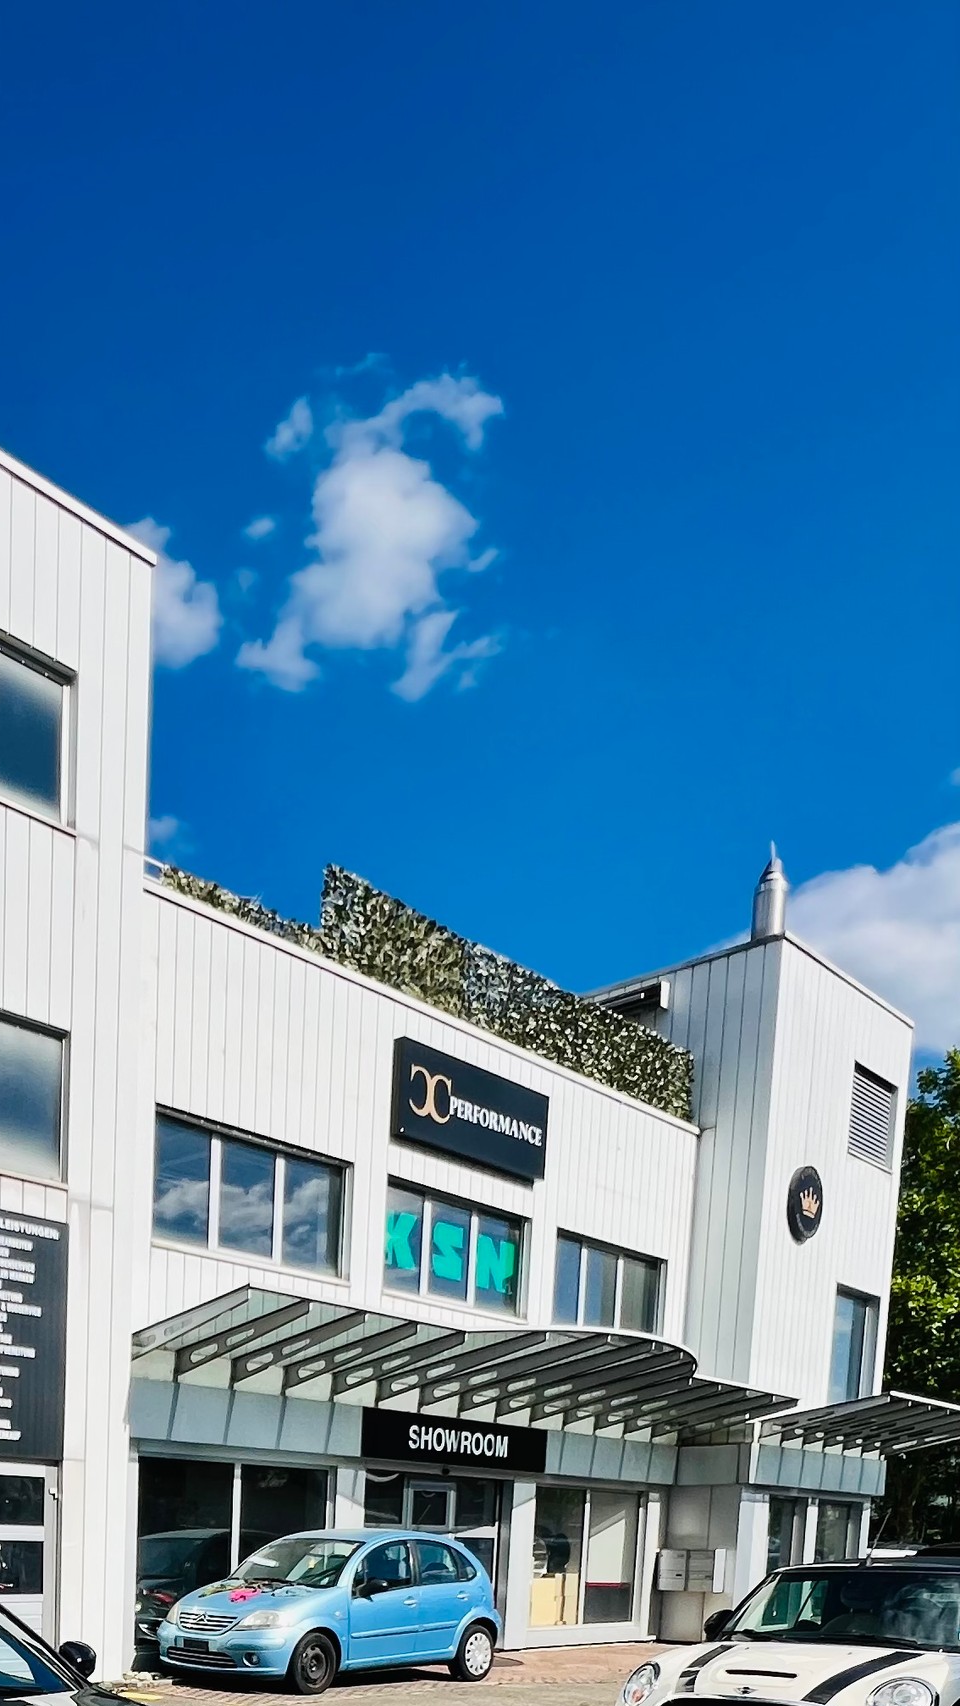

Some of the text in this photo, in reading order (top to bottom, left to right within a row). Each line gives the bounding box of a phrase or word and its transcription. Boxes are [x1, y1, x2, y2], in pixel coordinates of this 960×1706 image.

[449, 1095, 542, 1147] PERFORMANCE
[385, 1211, 515, 1294] KSN
[408, 1424, 509, 1458] SHOWROOM
